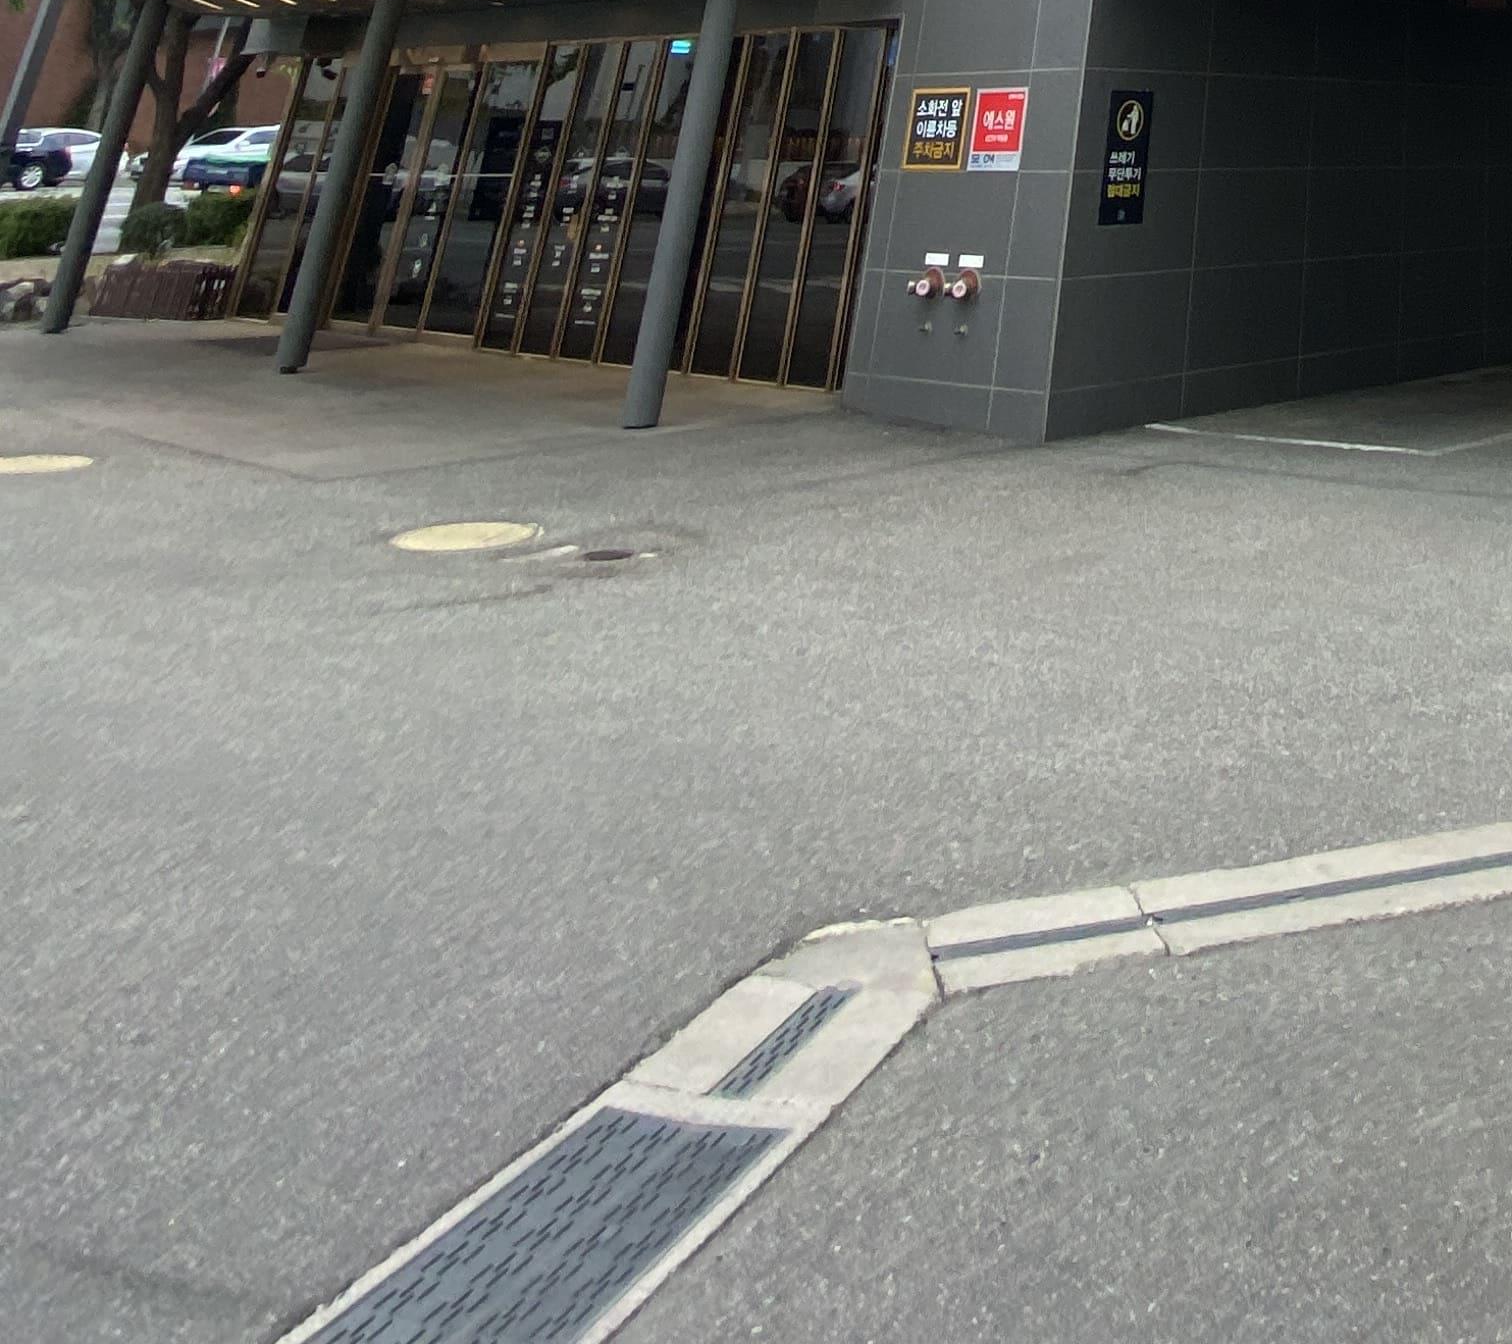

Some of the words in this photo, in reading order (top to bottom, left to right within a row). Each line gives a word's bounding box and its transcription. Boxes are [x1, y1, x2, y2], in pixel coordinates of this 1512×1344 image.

[916, 99, 948, 117] 소화전
[951, 100, 963, 117] 앞
[913, 141, 955, 160] 주차금지
[1108, 151, 1135, 165] 쓰레기
[1108, 167, 1142, 182] 무단투기
